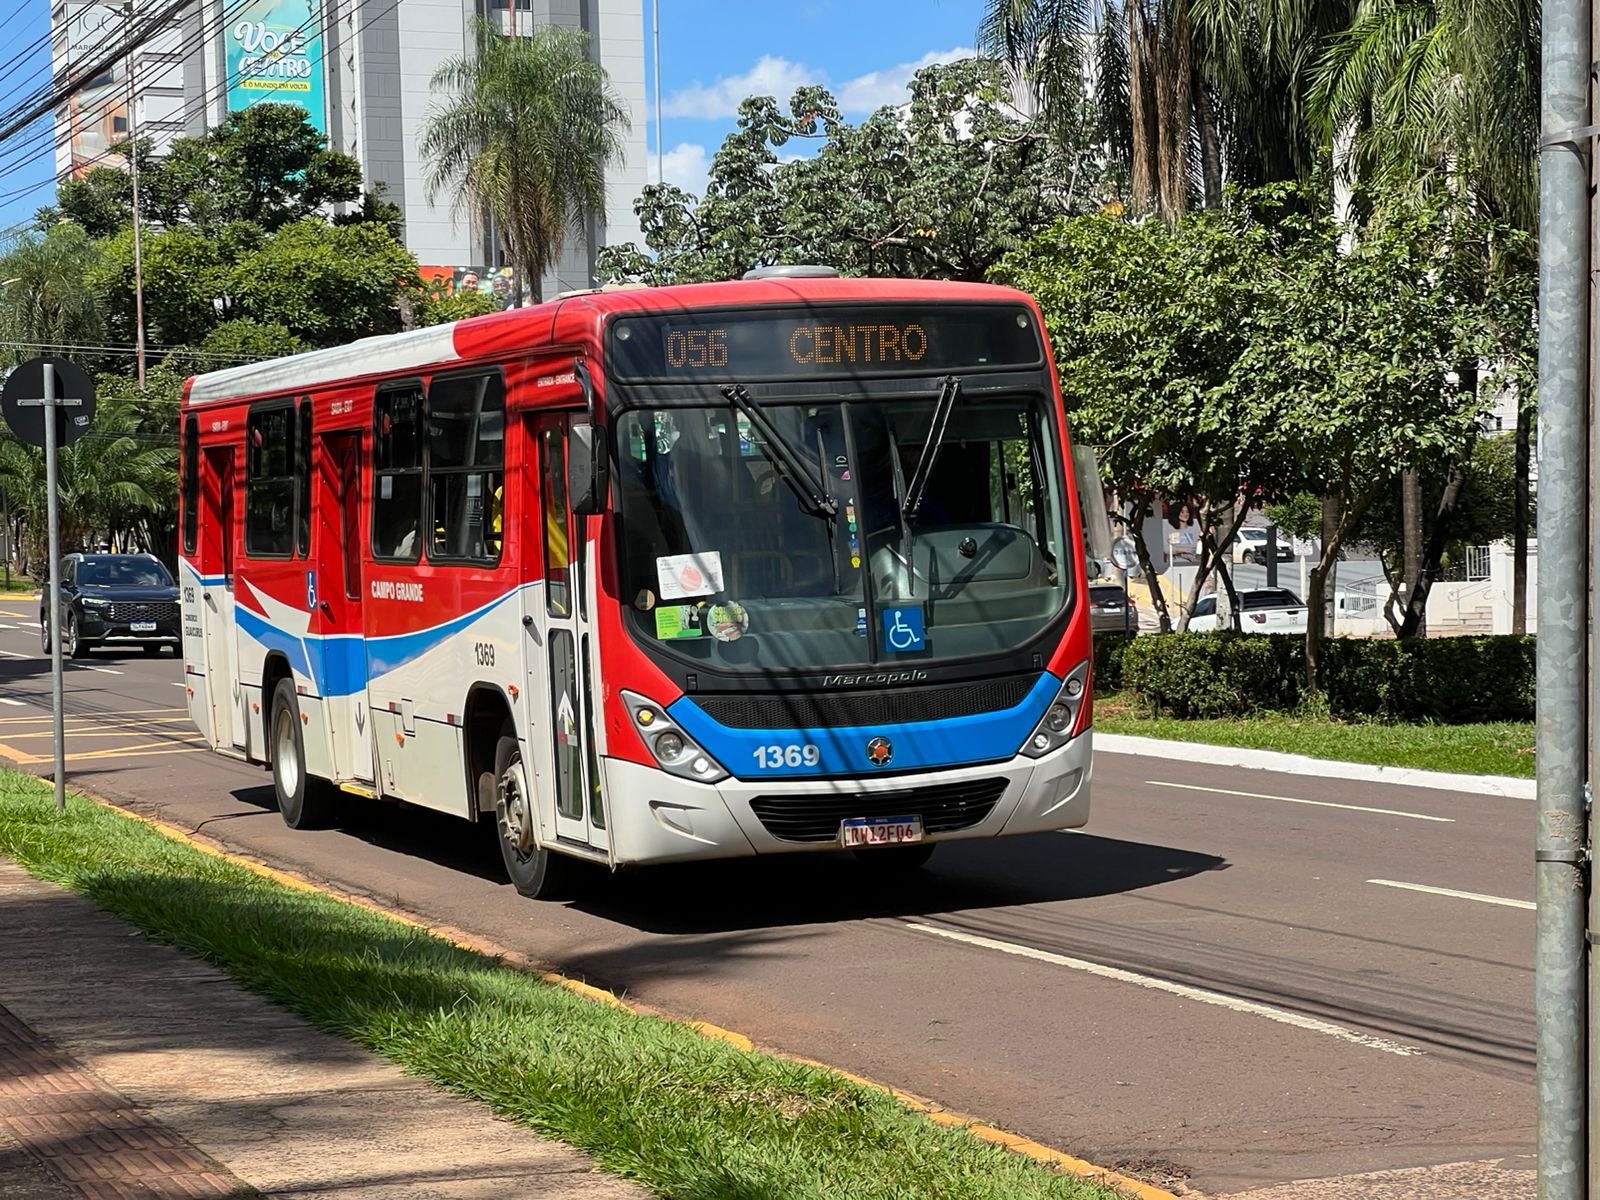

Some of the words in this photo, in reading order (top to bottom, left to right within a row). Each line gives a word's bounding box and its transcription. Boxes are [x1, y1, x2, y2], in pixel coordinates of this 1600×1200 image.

[238, 56, 312, 78] CENTRO
[667, 329, 728, 368] 056
[789, 324, 927, 364] CENTRO
[371, 580, 395, 600] CAMPO
[395, 582, 424, 603] GRANDE
[474, 642, 496, 667] 1369
[823, 669, 928, 687] Marcopolo
[753, 744, 820, 769] 1369
